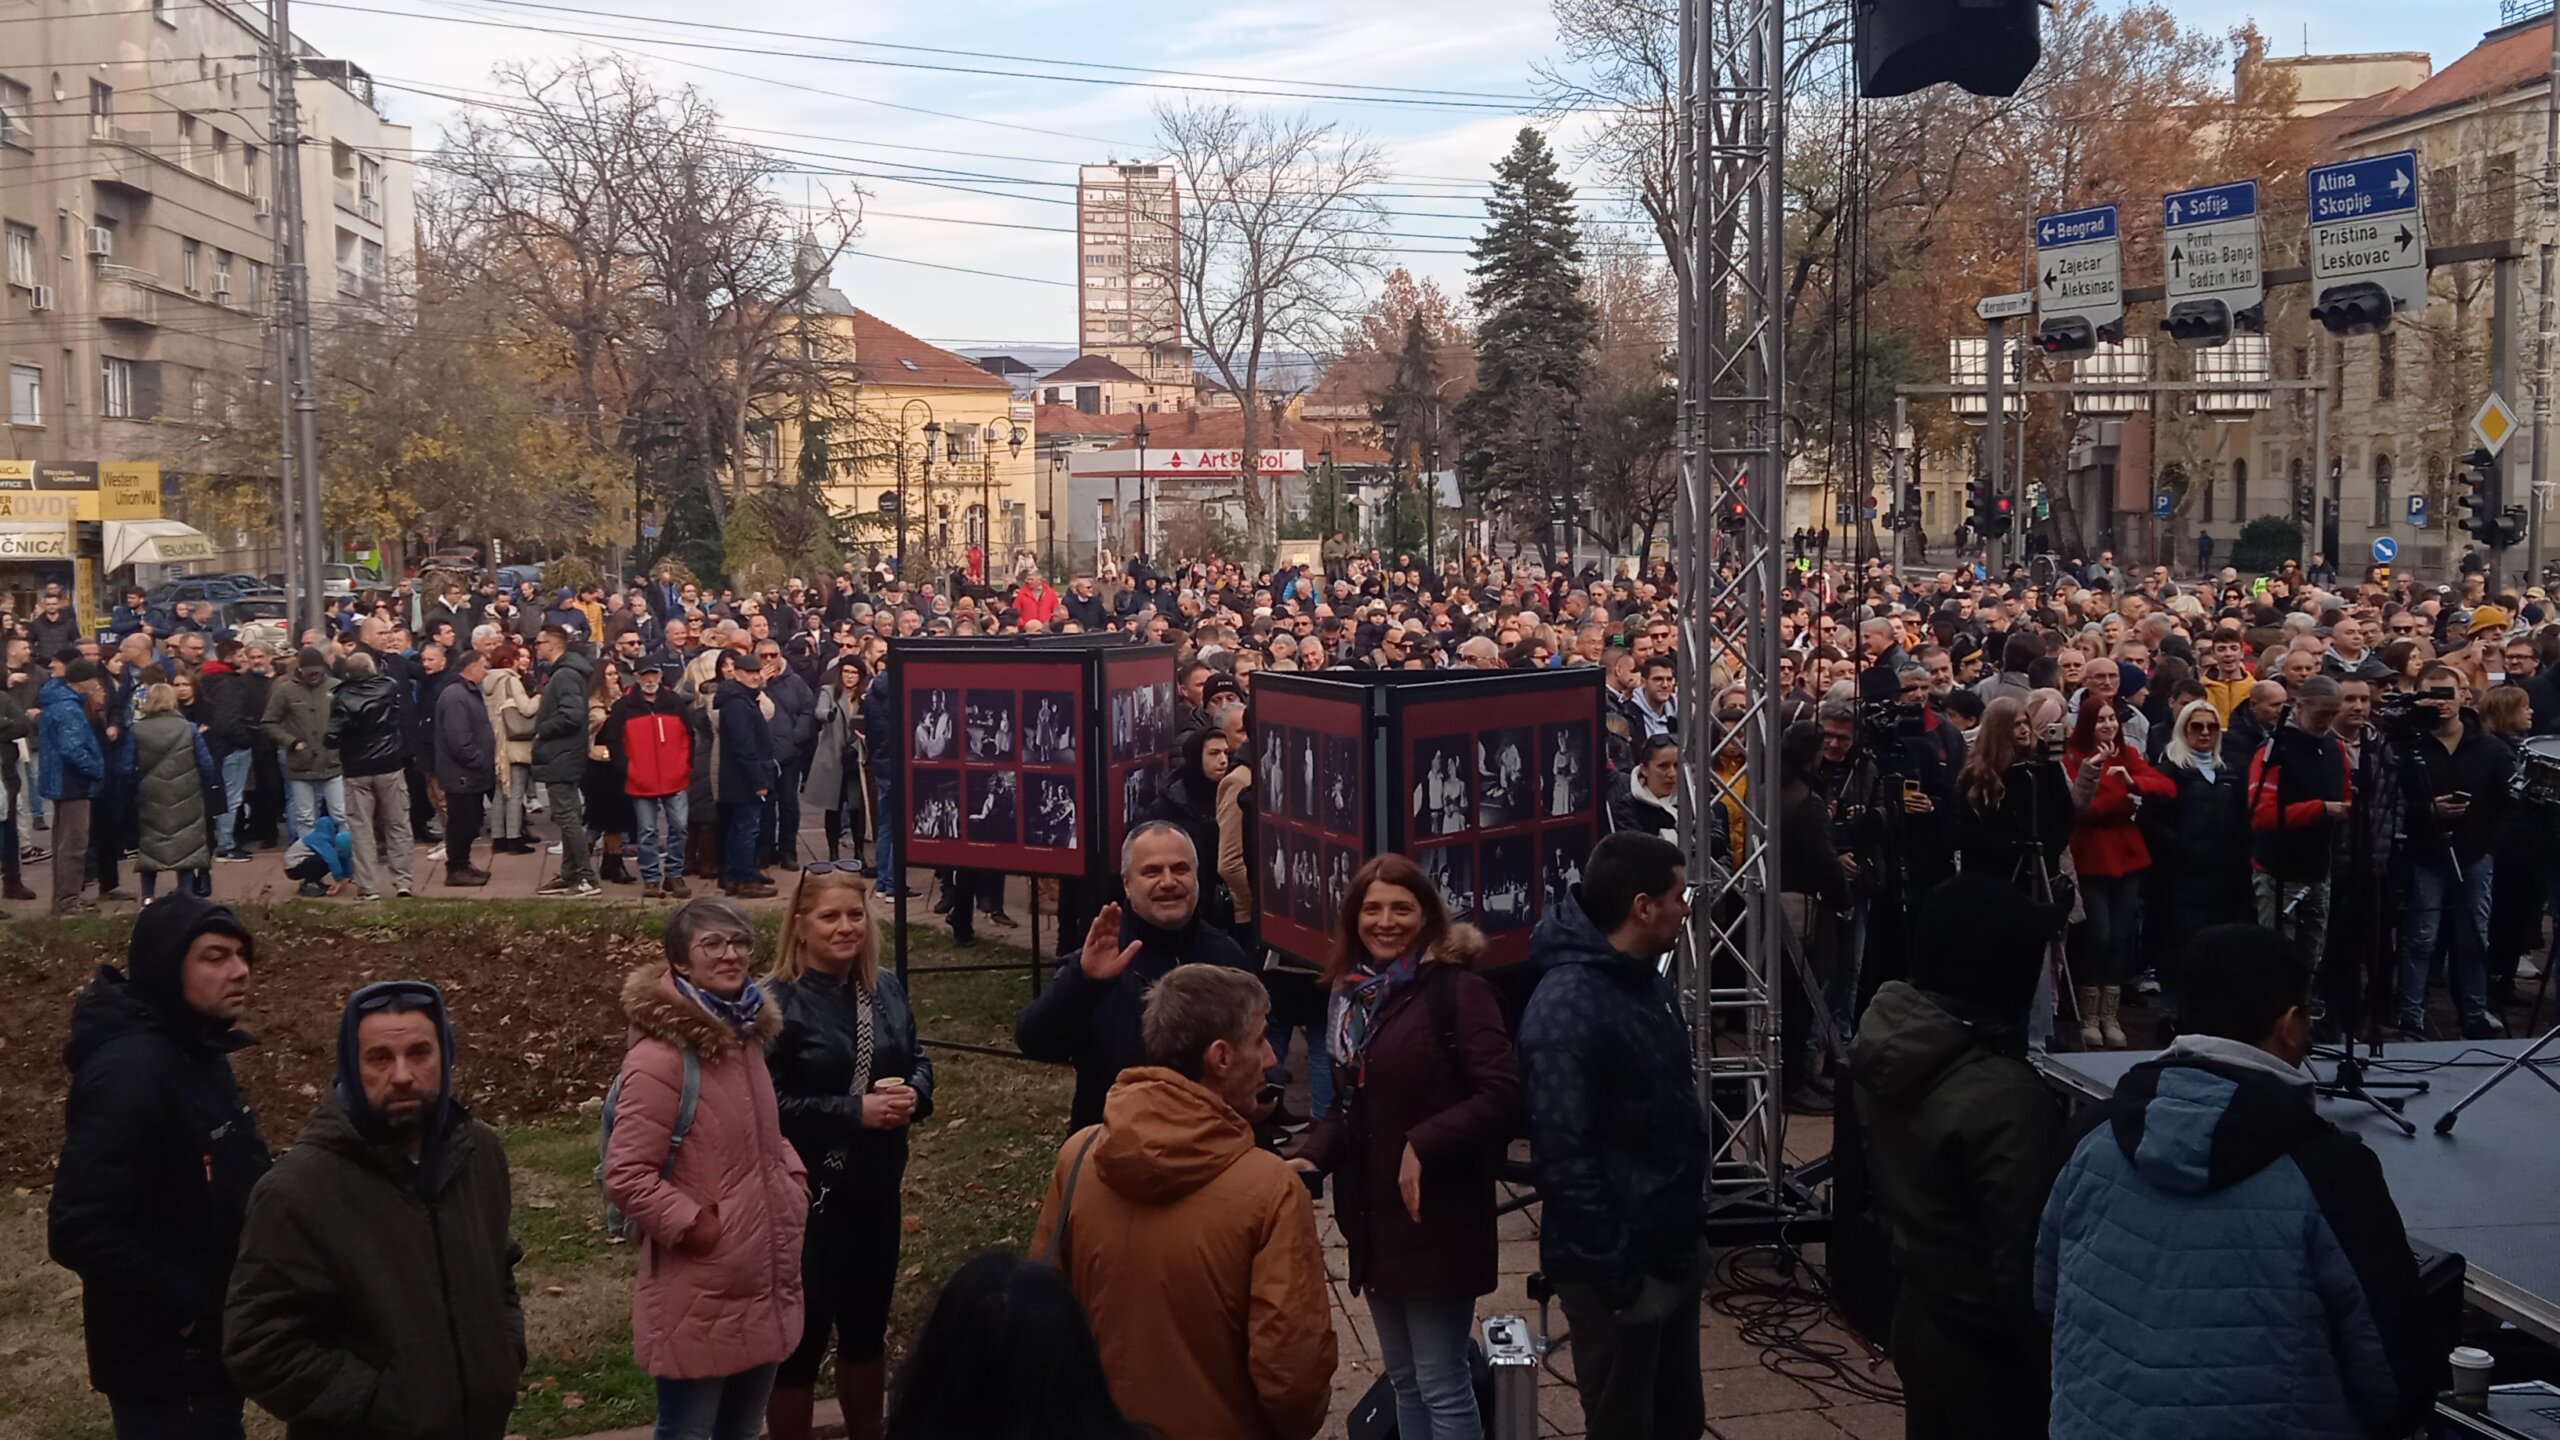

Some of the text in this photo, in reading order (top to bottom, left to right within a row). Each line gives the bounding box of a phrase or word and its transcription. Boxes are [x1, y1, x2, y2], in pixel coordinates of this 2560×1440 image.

[2318, 172, 2356, 192] Atina
[2190, 194, 2228, 216] Sofija
[2319, 192, 2372, 215] Skoplje
[2057, 215, 2105, 239] Beograd
[2320, 225, 2378, 247] Priština
[2186, 230, 2213, 248] Pirot
[2188, 245, 2254, 267] Niška Banja
[2321, 249, 2391, 270] Leskovac
[2059, 256, 2102, 277] Zaječar
[2188, 267, 2252, 289] Gadžin Han
[2061, 280, 2115, 299] Aleksinac
[1198, 451, 1283, 468] Art Prol
[102, 471, 139, 488] Western
[115, 488, 140, 505] Union
[2157, 496, 2169, 509] P
[2411, 497, 2424, 513] P
